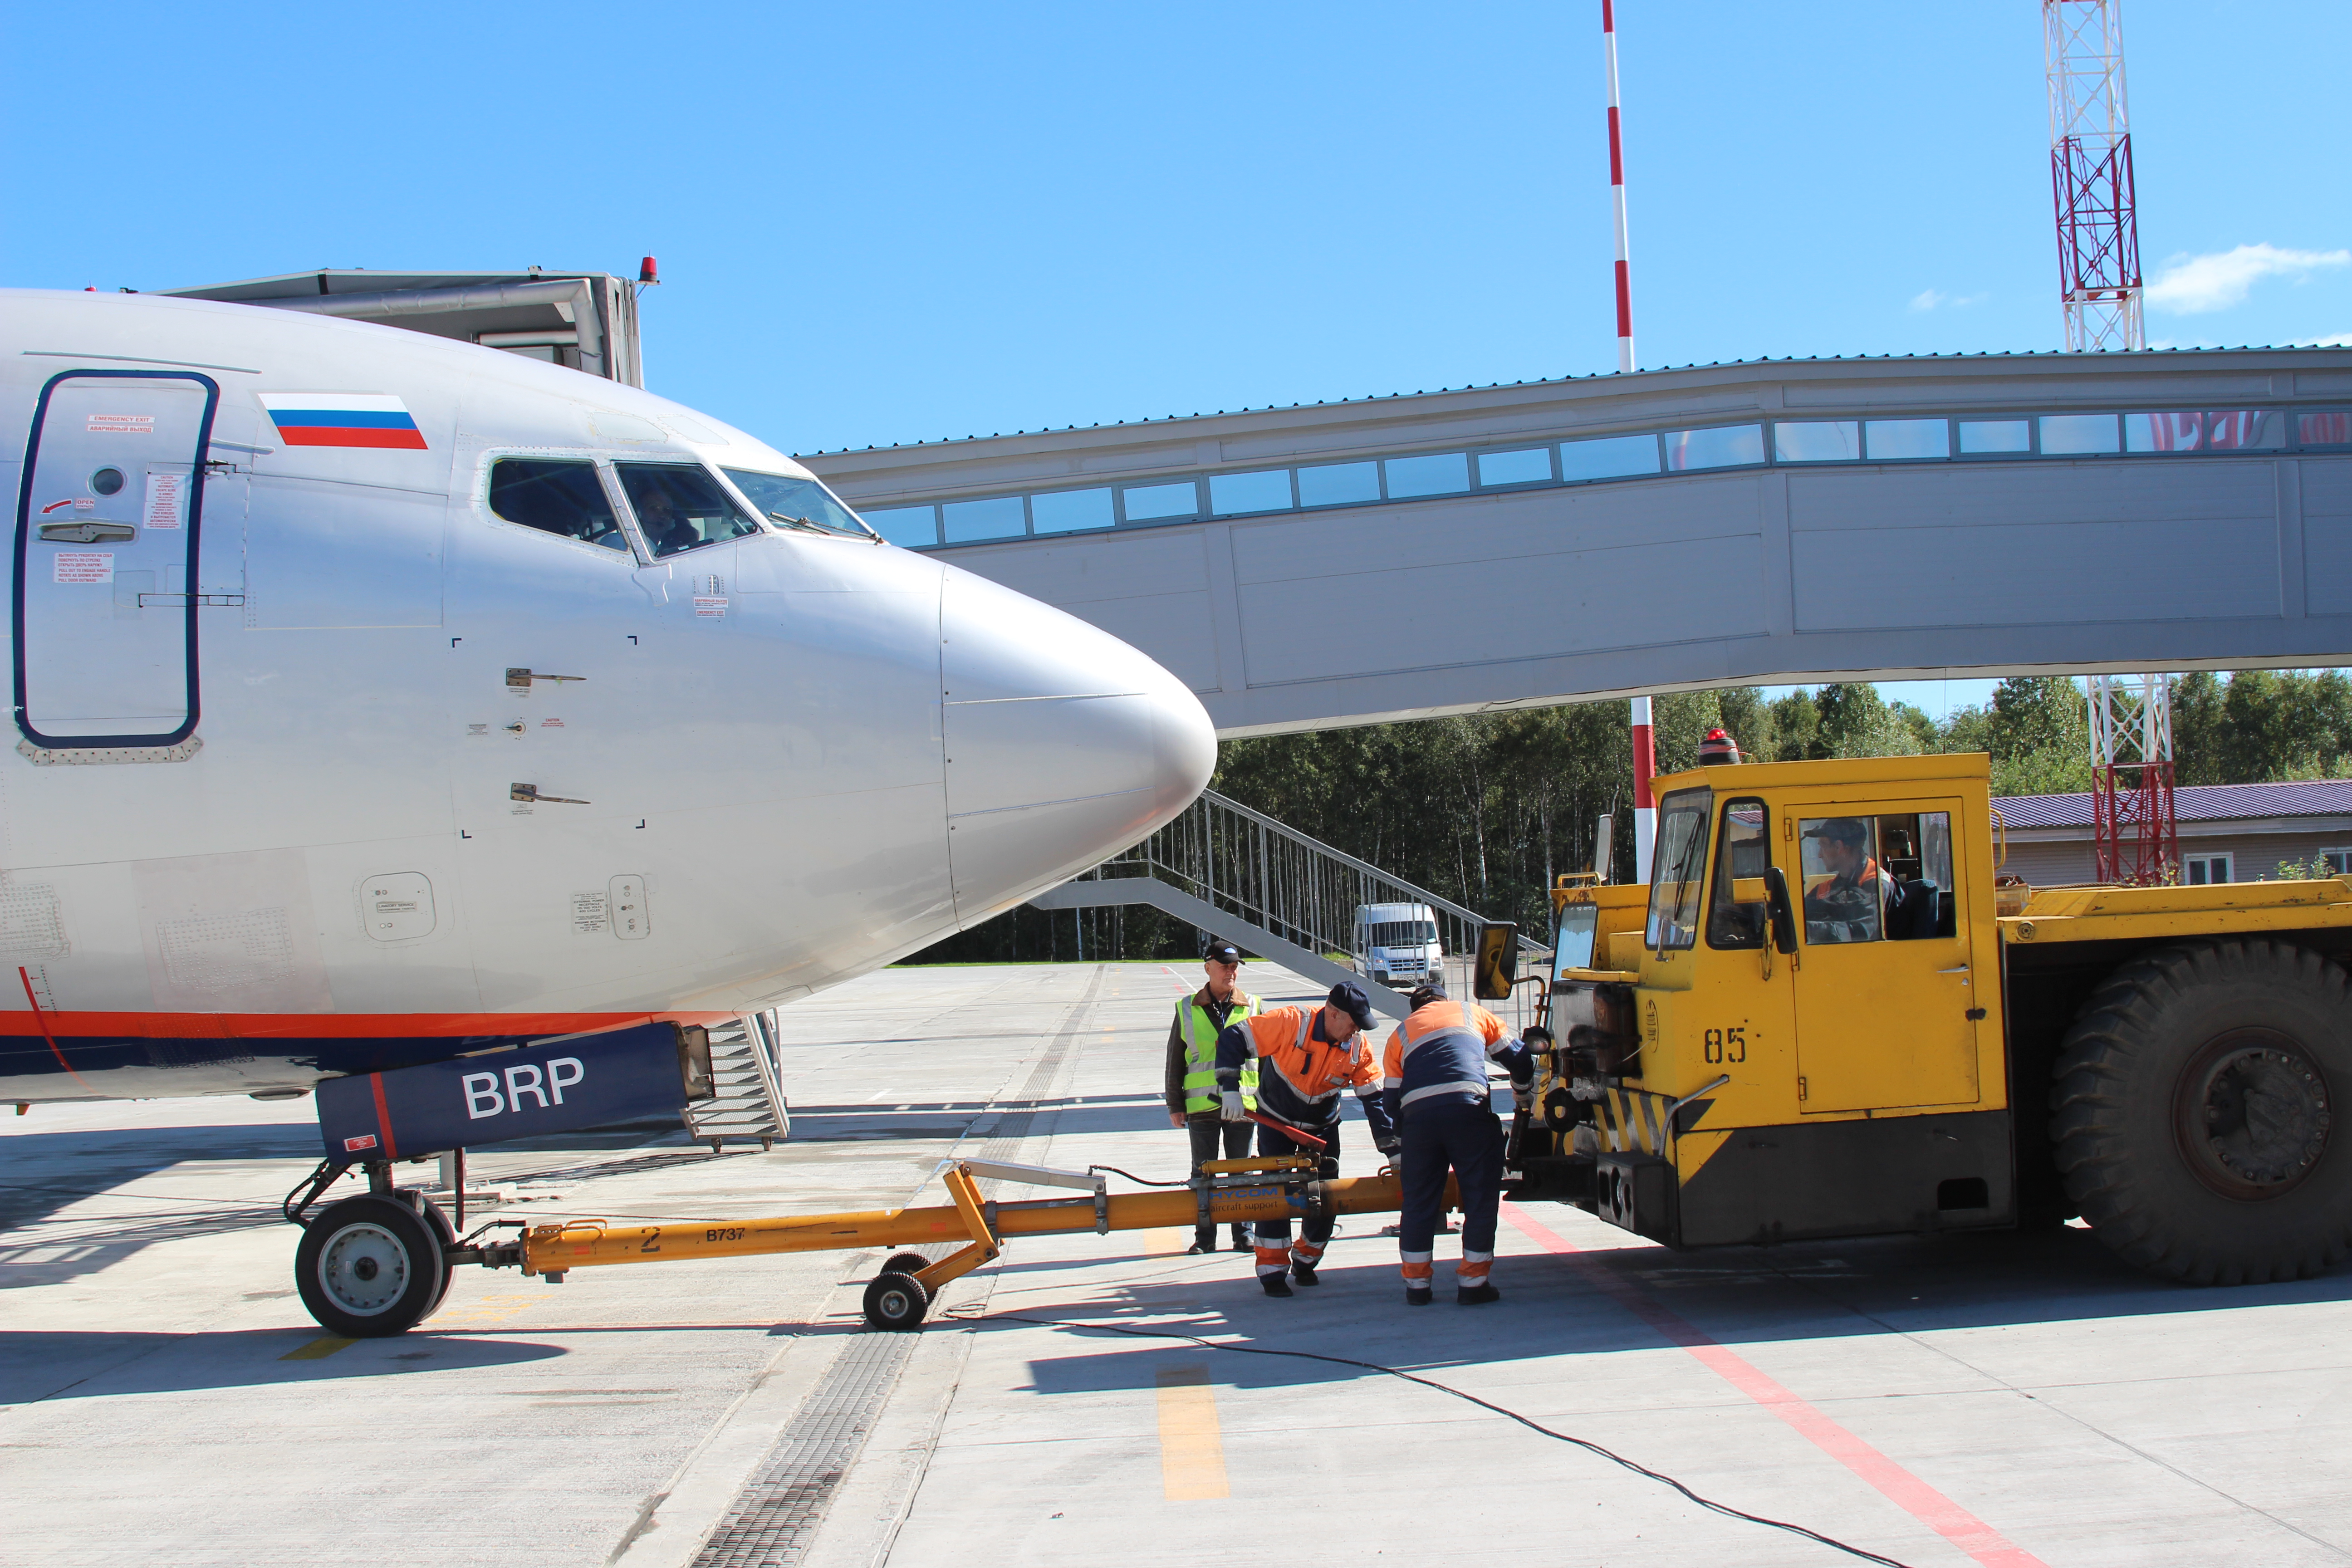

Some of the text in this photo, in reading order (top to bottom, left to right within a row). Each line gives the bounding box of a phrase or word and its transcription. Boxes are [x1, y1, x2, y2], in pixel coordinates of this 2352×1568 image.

[1705, 1028, 1745, 1063] 85
[462, 1057, 585, 1120] BRP
[1210, 1187, 1278, 1200] HYCOM
[1211, 1201, 1278, 1212] aircraft support
[641, 1227, 661, 1253] 2
[707, 1227, 745, 1242] B737
